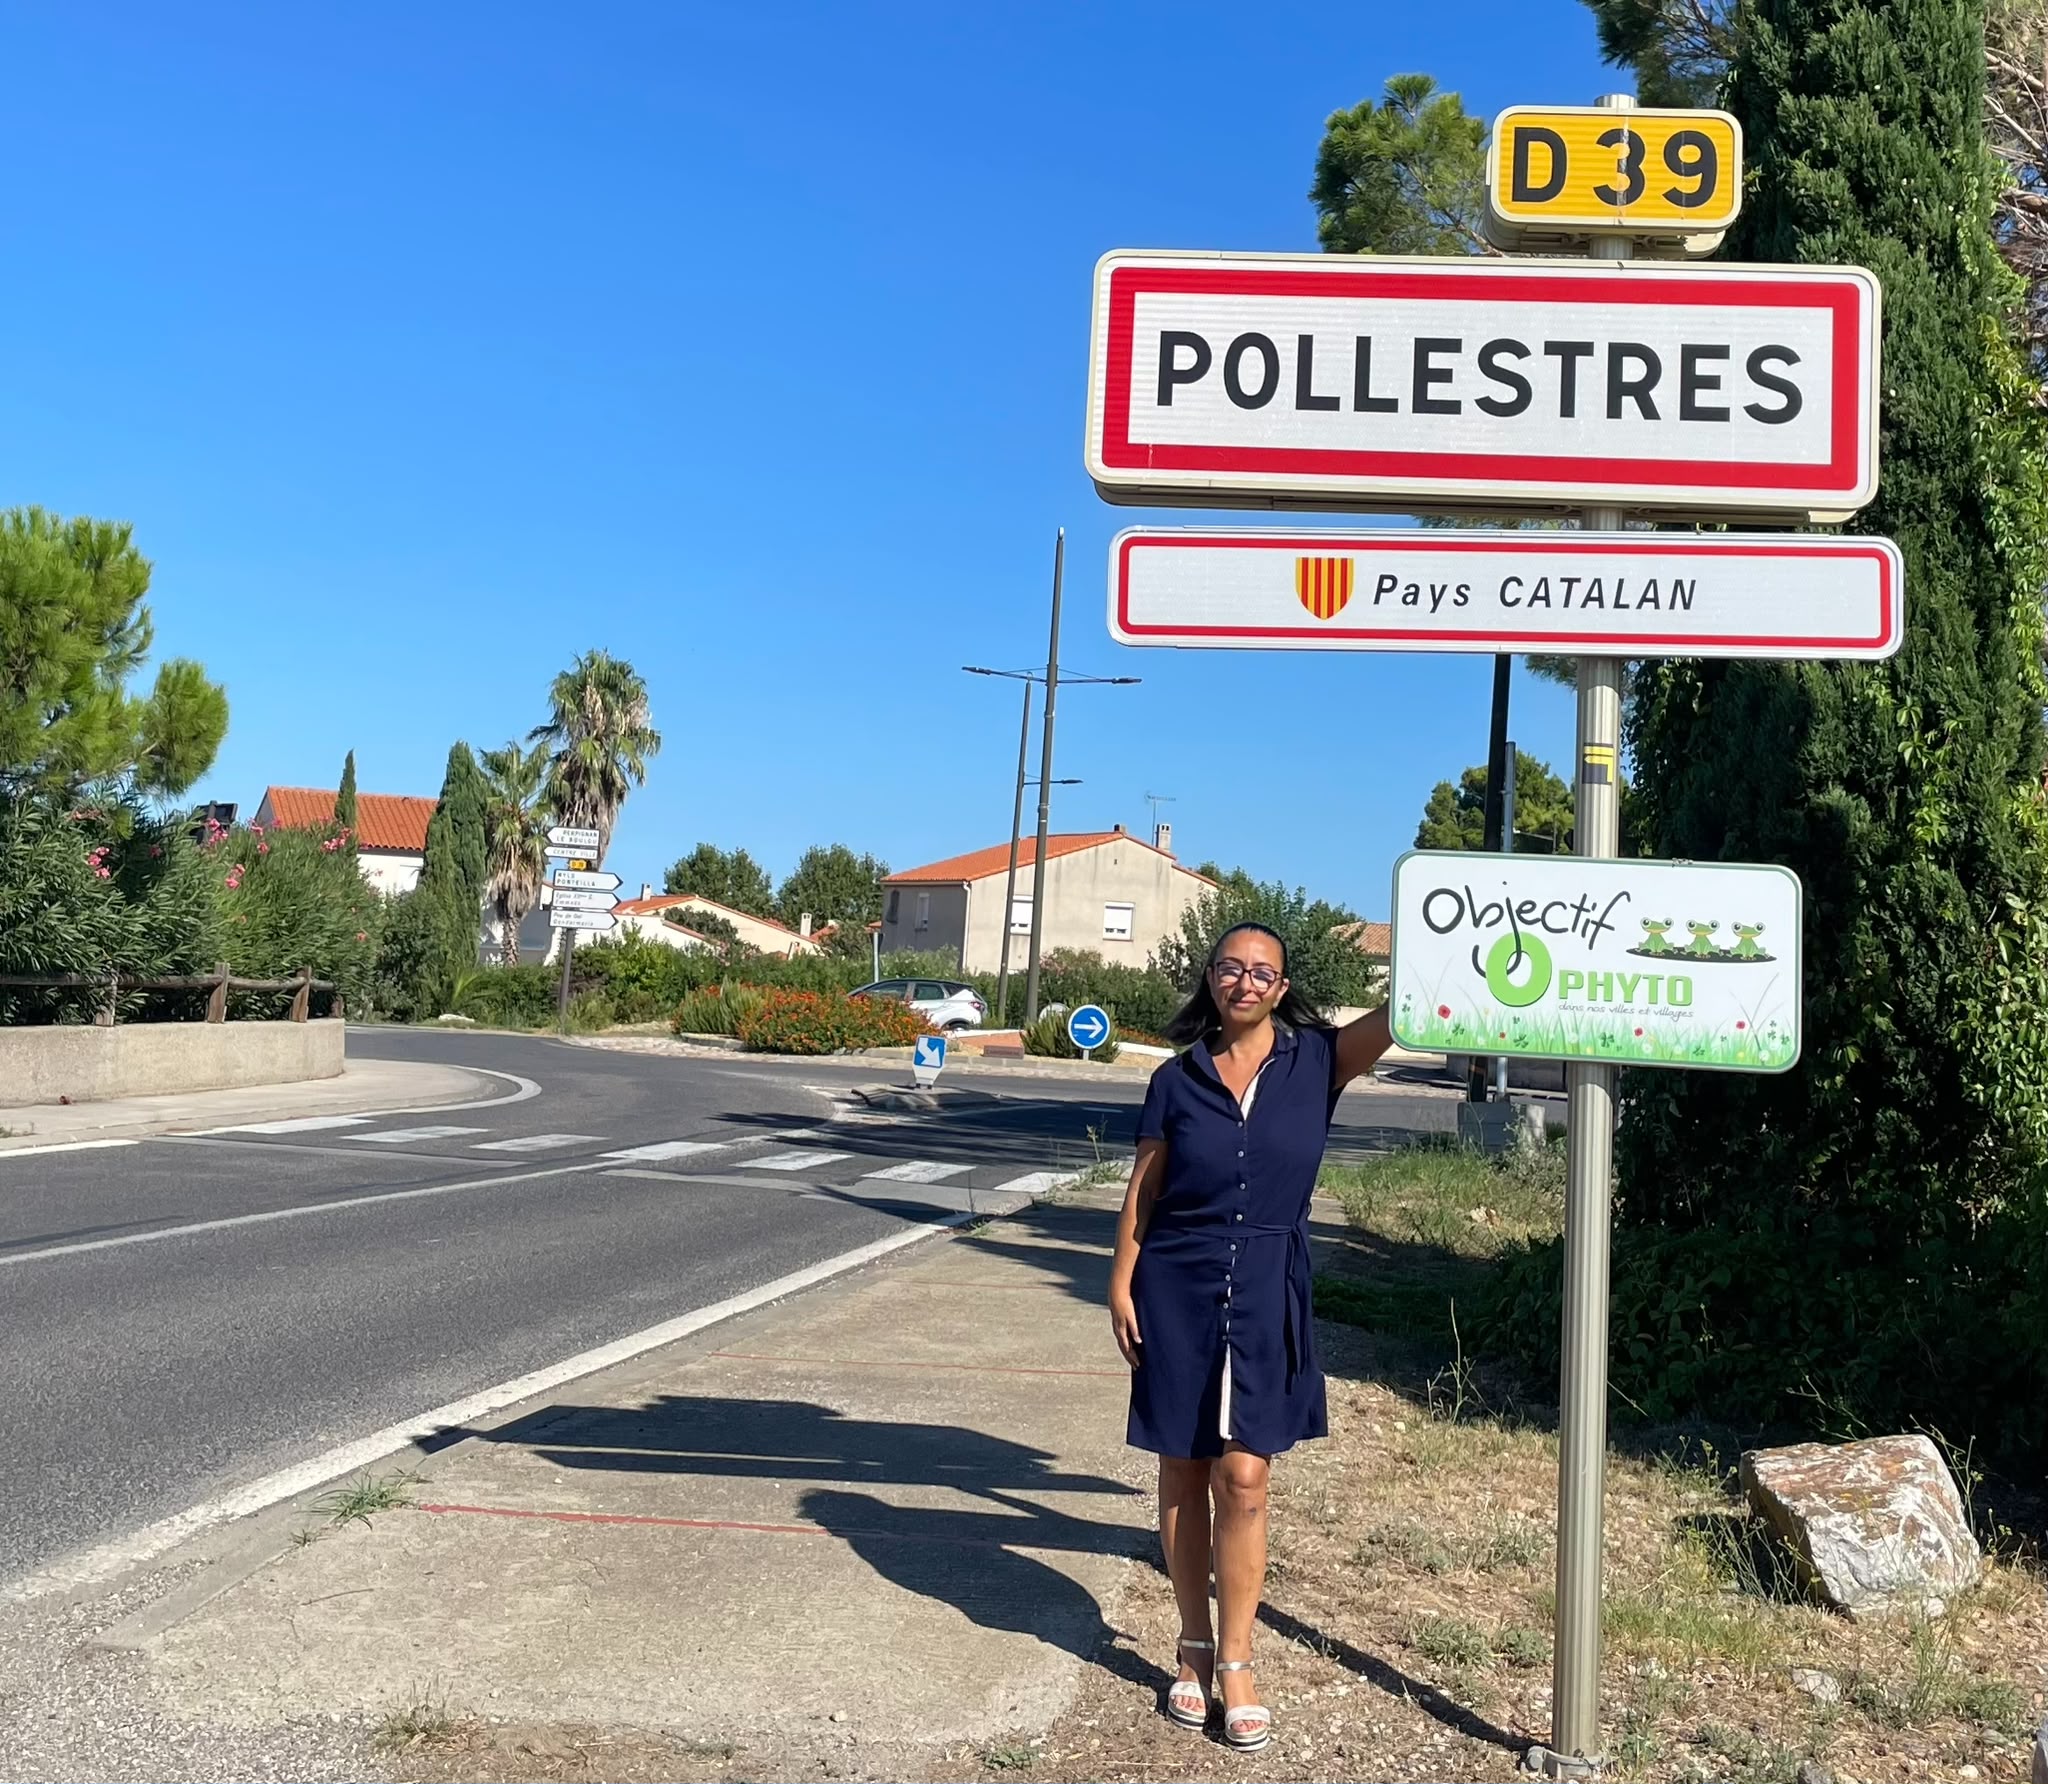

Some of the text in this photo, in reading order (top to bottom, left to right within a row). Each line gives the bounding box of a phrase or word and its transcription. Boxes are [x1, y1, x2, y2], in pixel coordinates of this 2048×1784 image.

[1511, 126, 1718, 208] D 39
[1156, 329, 1803, 425] POLLESTRES
[1372, 573, 1697, 614] Pays CATALAN
[556, 878, 596, 887] PONTEILLA
[1422, 880, 1631, 979] Objectif
[1558, 969, 1693, 1007] PHYTO
[1558, 1001, 1695, 1023] dans nos villes et villages
